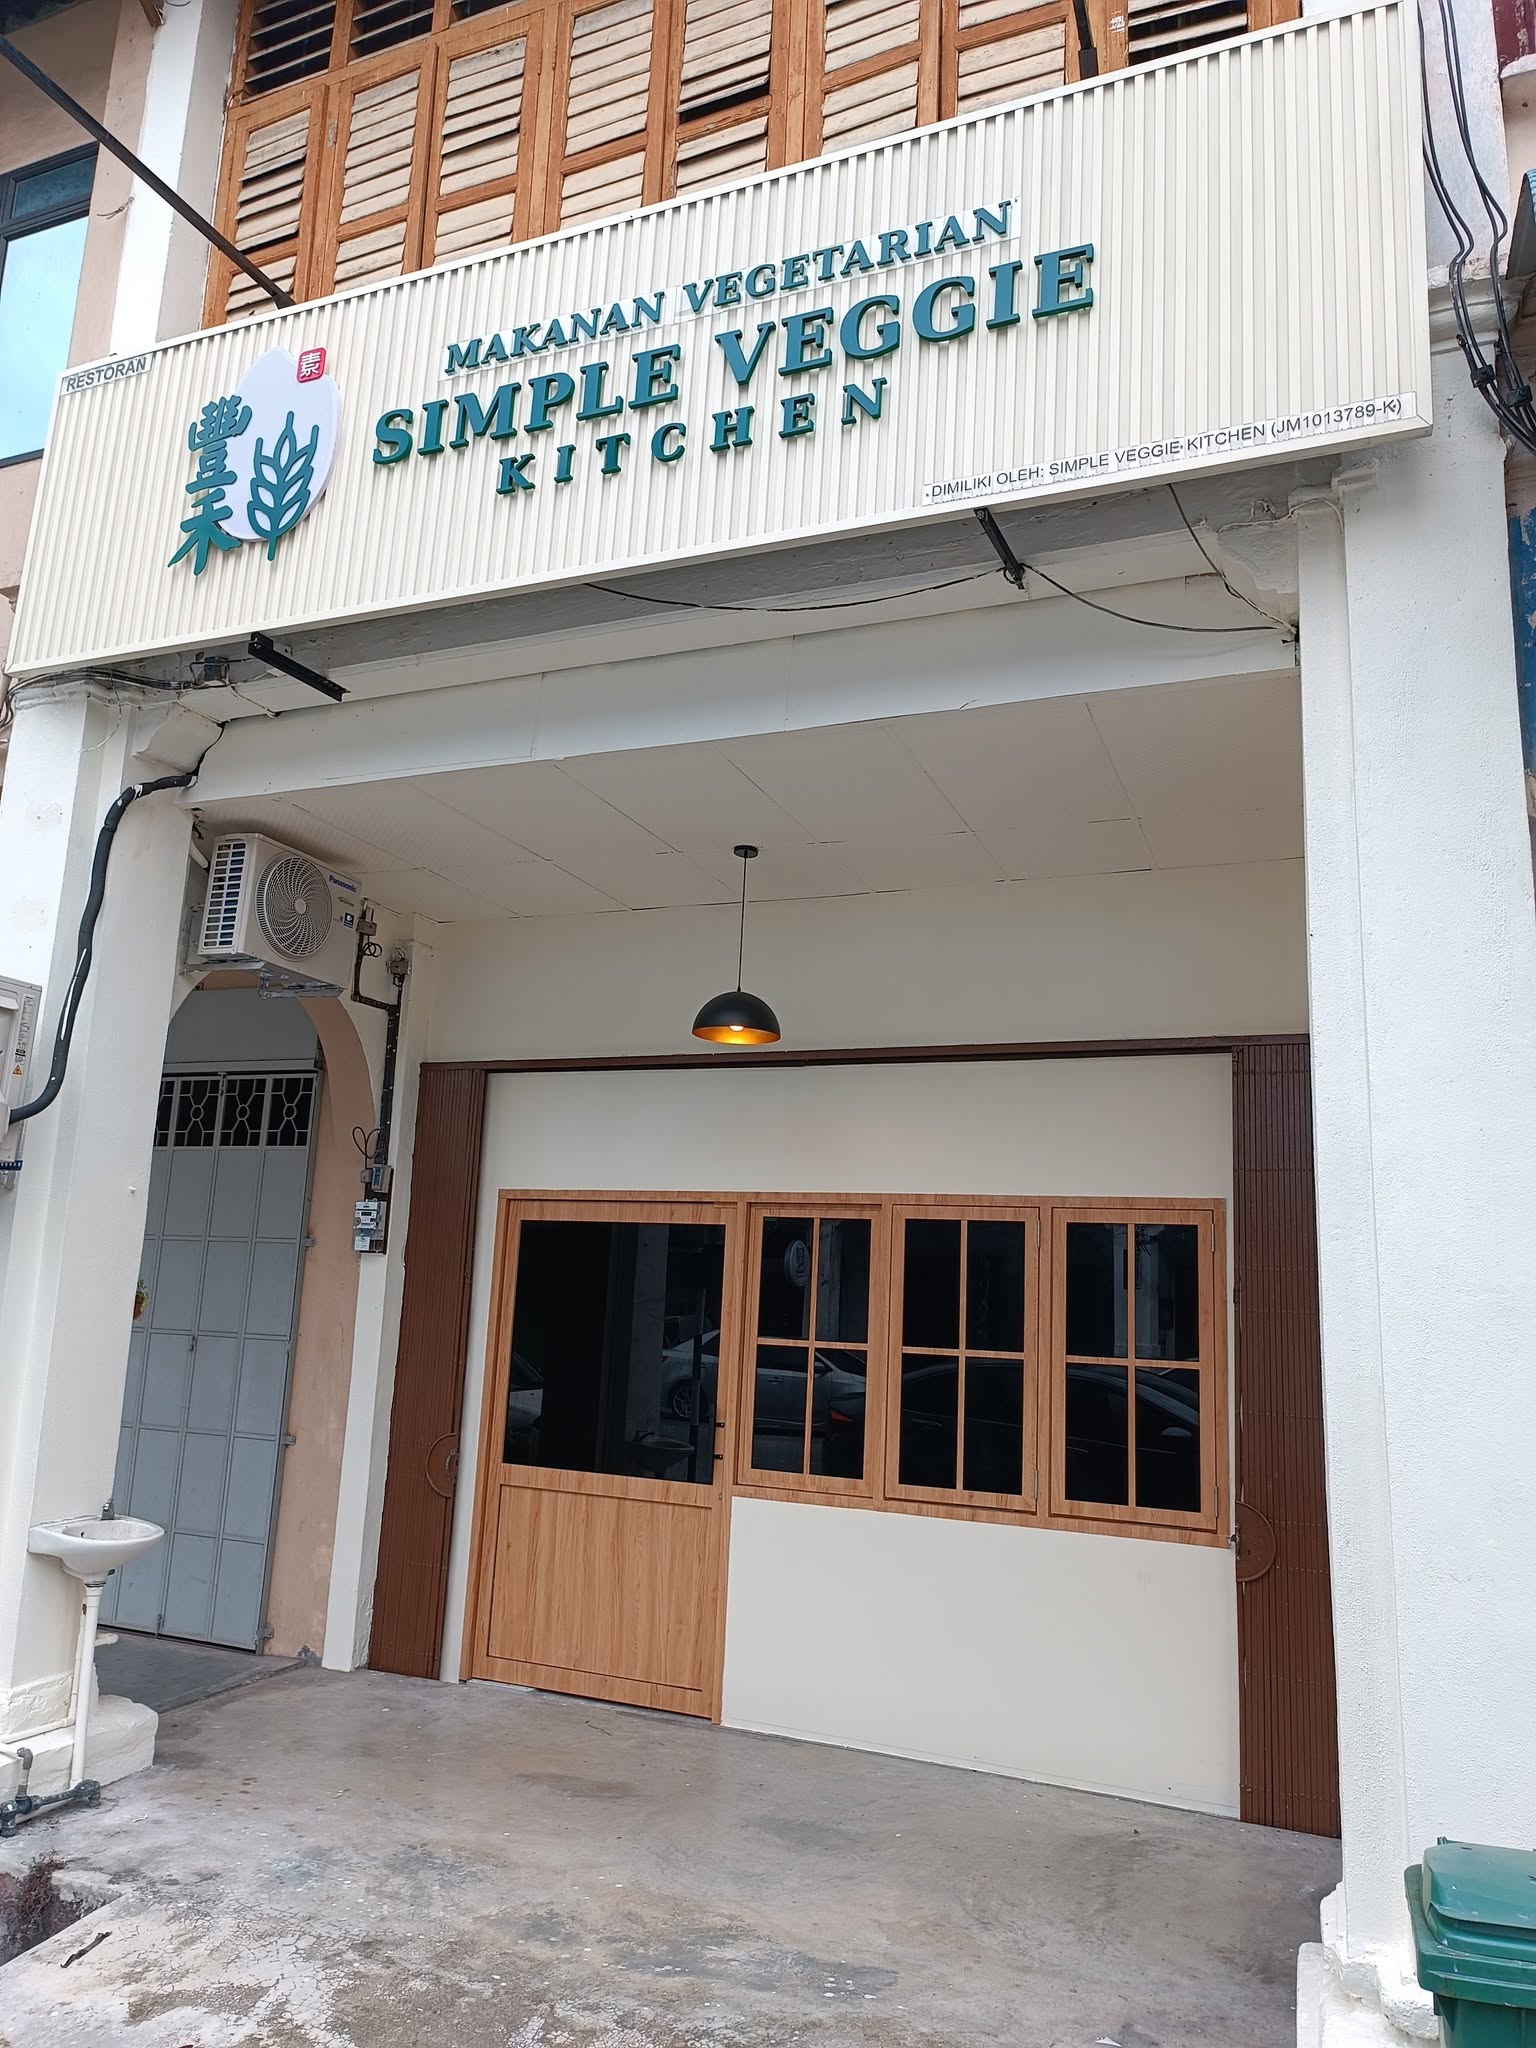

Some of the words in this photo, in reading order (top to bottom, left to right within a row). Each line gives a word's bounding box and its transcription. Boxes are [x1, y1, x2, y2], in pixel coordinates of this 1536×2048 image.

[446, 291, 665, 376] MAKANAN
[682, 201, 1012, 313] VEGETARIAN
[66, 357, 147, 392] RESTORAN
[299, 351, 322, 378] 素
[372, 344, 681, 465] SIMPLE
[715, 243, 1095, 385] VEGGIE
[495, 377, 888, 495] KITCHEN
[931, 475, 992, 497] DIMILIKI
[996, 465, 1044, 485] OLEH:
[1049, 453, 1110, 476] SIMPLE
[1114, 440, 1181, 463] VEGGIE
[1187, 423, 1266, 451] KITCHEN
[1270, 398, 1402, 438] (JM1013789-K)
